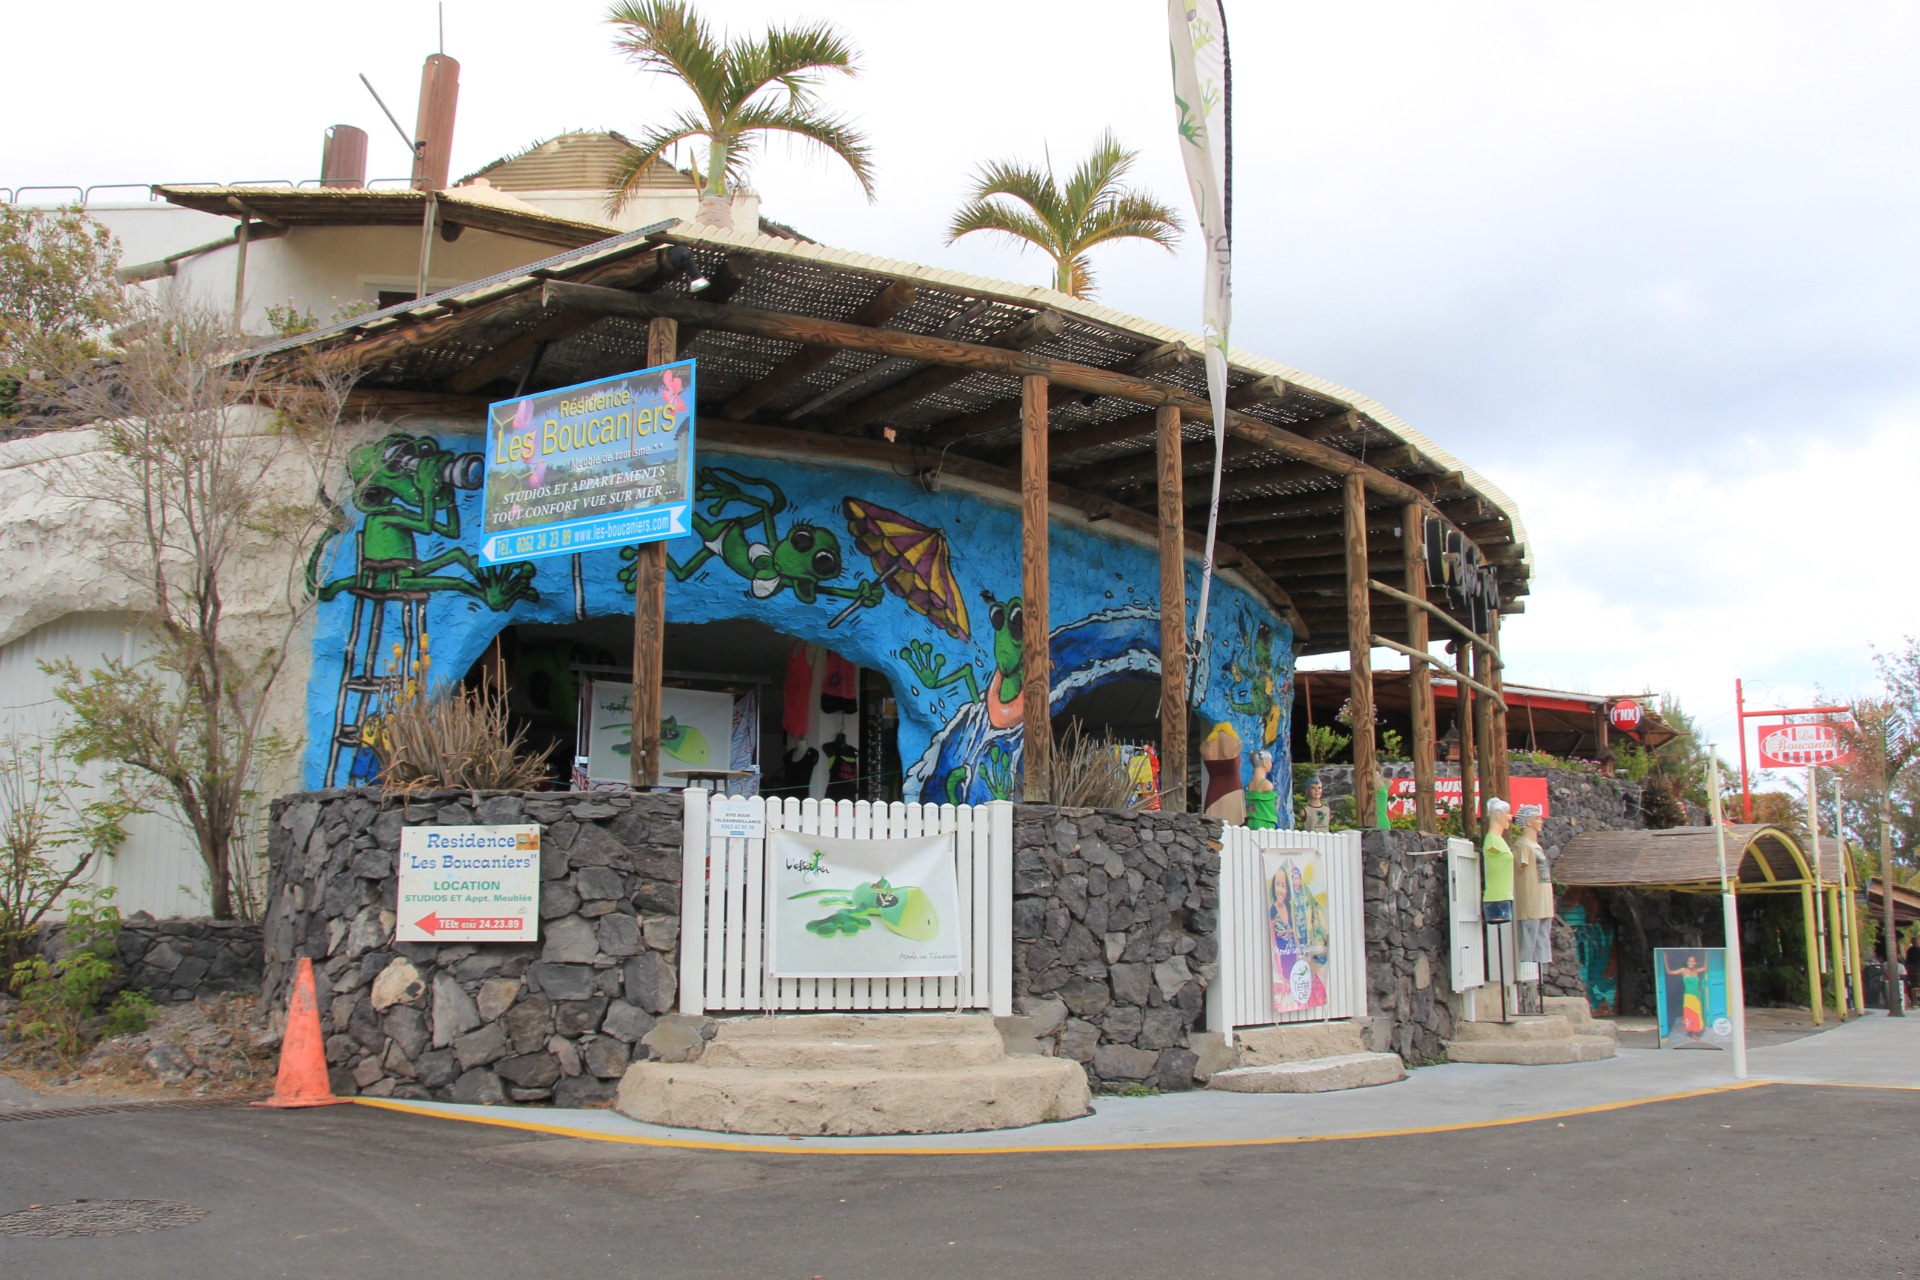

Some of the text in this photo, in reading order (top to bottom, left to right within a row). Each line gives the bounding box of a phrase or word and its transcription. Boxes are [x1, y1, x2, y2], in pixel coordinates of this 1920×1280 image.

[559, 390, 631, 418] Résidence
[495, 398, 677, 464] Les Boucaniers
[602, 452, 612, 463] de
[502, 465, 667, 505] STUDIOS ET APPARTEMENTS
[492, 508, 522, 525] TOUT
[525, 498, 580, 519] CONFORT
[583, 494, 607, 509] VUE
[609, 489, 632, 504] SUR
[633, 485, 662, 500] MER
[516, 536, 535, 552] 0262
[537, 533, 547, 549] 24
[549, 531, 559, 547] 23
[562, 529, 572, 545] 89
[573, 515, 669, 543] www.les-boucaniers.com
[427, 833, 515, 849] Residence
[433, 881, 501, 891] LOCATION
[404, 893, 533, 904] STUDIOS ET Appt. Meublés
[478, 919, 520, 929] 24.23.89
